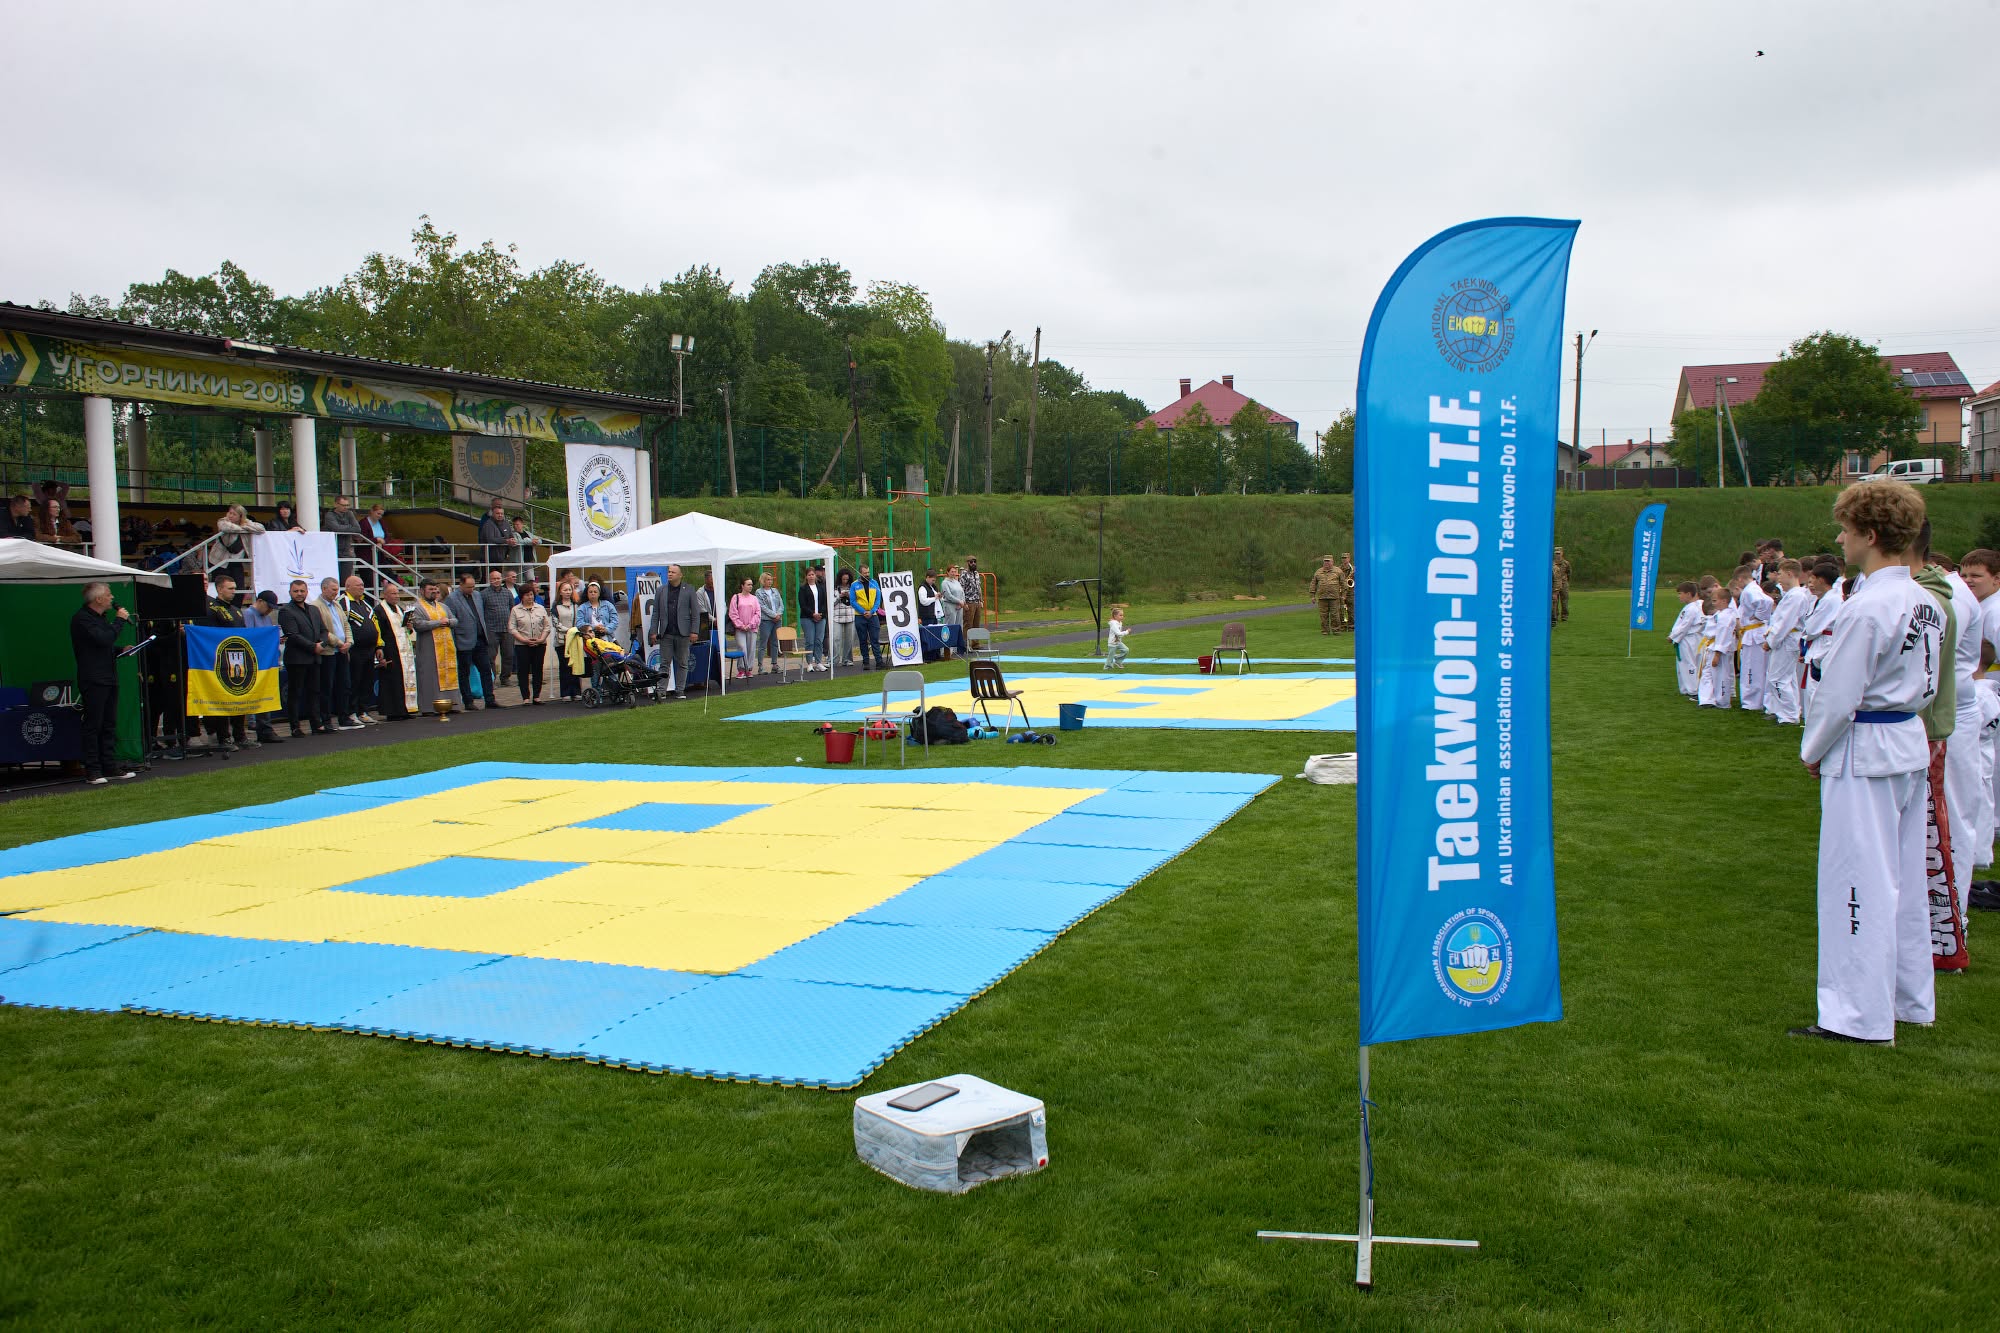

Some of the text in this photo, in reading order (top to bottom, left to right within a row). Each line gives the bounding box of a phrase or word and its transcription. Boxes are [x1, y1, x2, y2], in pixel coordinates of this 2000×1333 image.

[1431, 278, 1515, 374] INTERNATIONAL TAEKWON-DO FEDERATION
[48, 350, 305, 404] УГОРНИКИ-2019
[880, 574, 912, 589] RING
[889, 590, 911, 627] 3
[1426, 390, 1481, 891] Taekwon-Do I.T.F.
[1496, 394, 1517, 886] All Ukrainian association of sportsmen Taekwon-Do I.T.F.
[1432, 911, 1465, 957] ASSOCIATION
[1466, 907, 1476, 915] OF
[1478, 907, 1509, 940] SPORTSMEN
[1848, 886, 1860, 935] ITF
[1432, 959, 1457, 1001] UKRAINIAN
[1499, 940, 1513, 994] TAEKWON-DO
